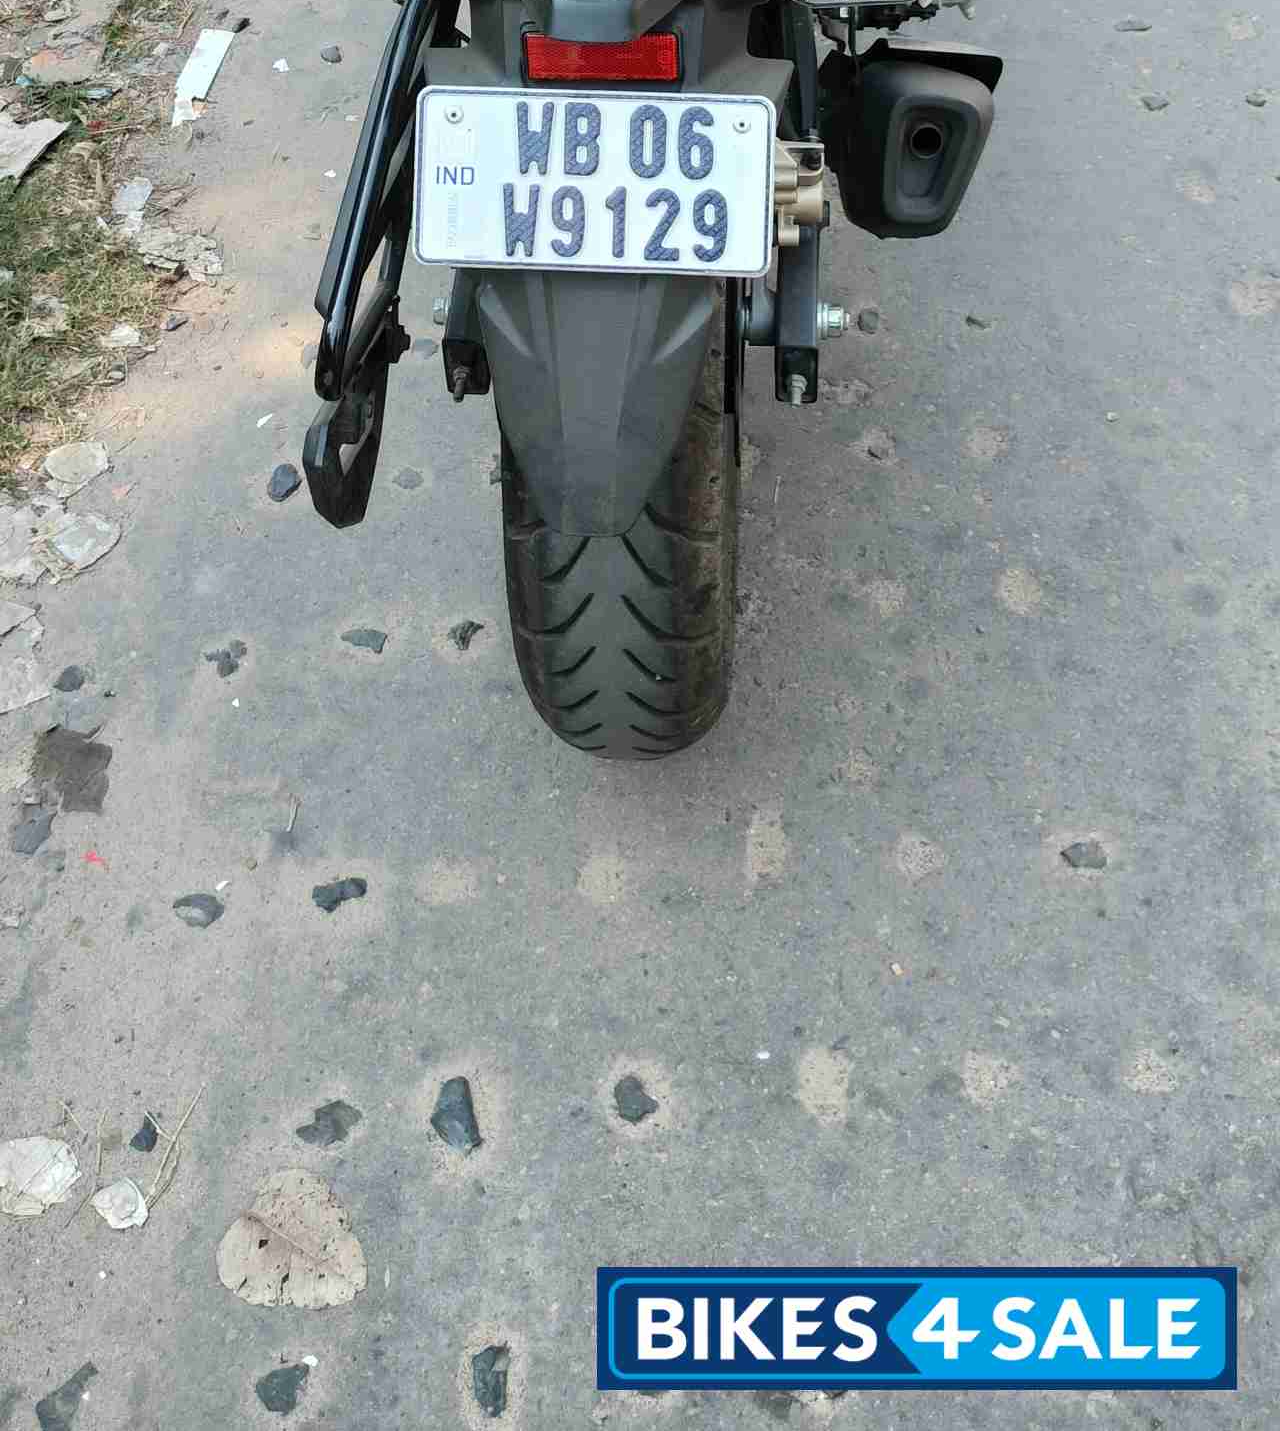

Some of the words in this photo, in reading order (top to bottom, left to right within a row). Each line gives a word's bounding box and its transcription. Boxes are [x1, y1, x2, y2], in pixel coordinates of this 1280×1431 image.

[436, 166, 475, 186] IND
[516, 101, 602, 176] WB
[629, 104, 714, 180] 06
[502, 182, 728, 262] W9129
